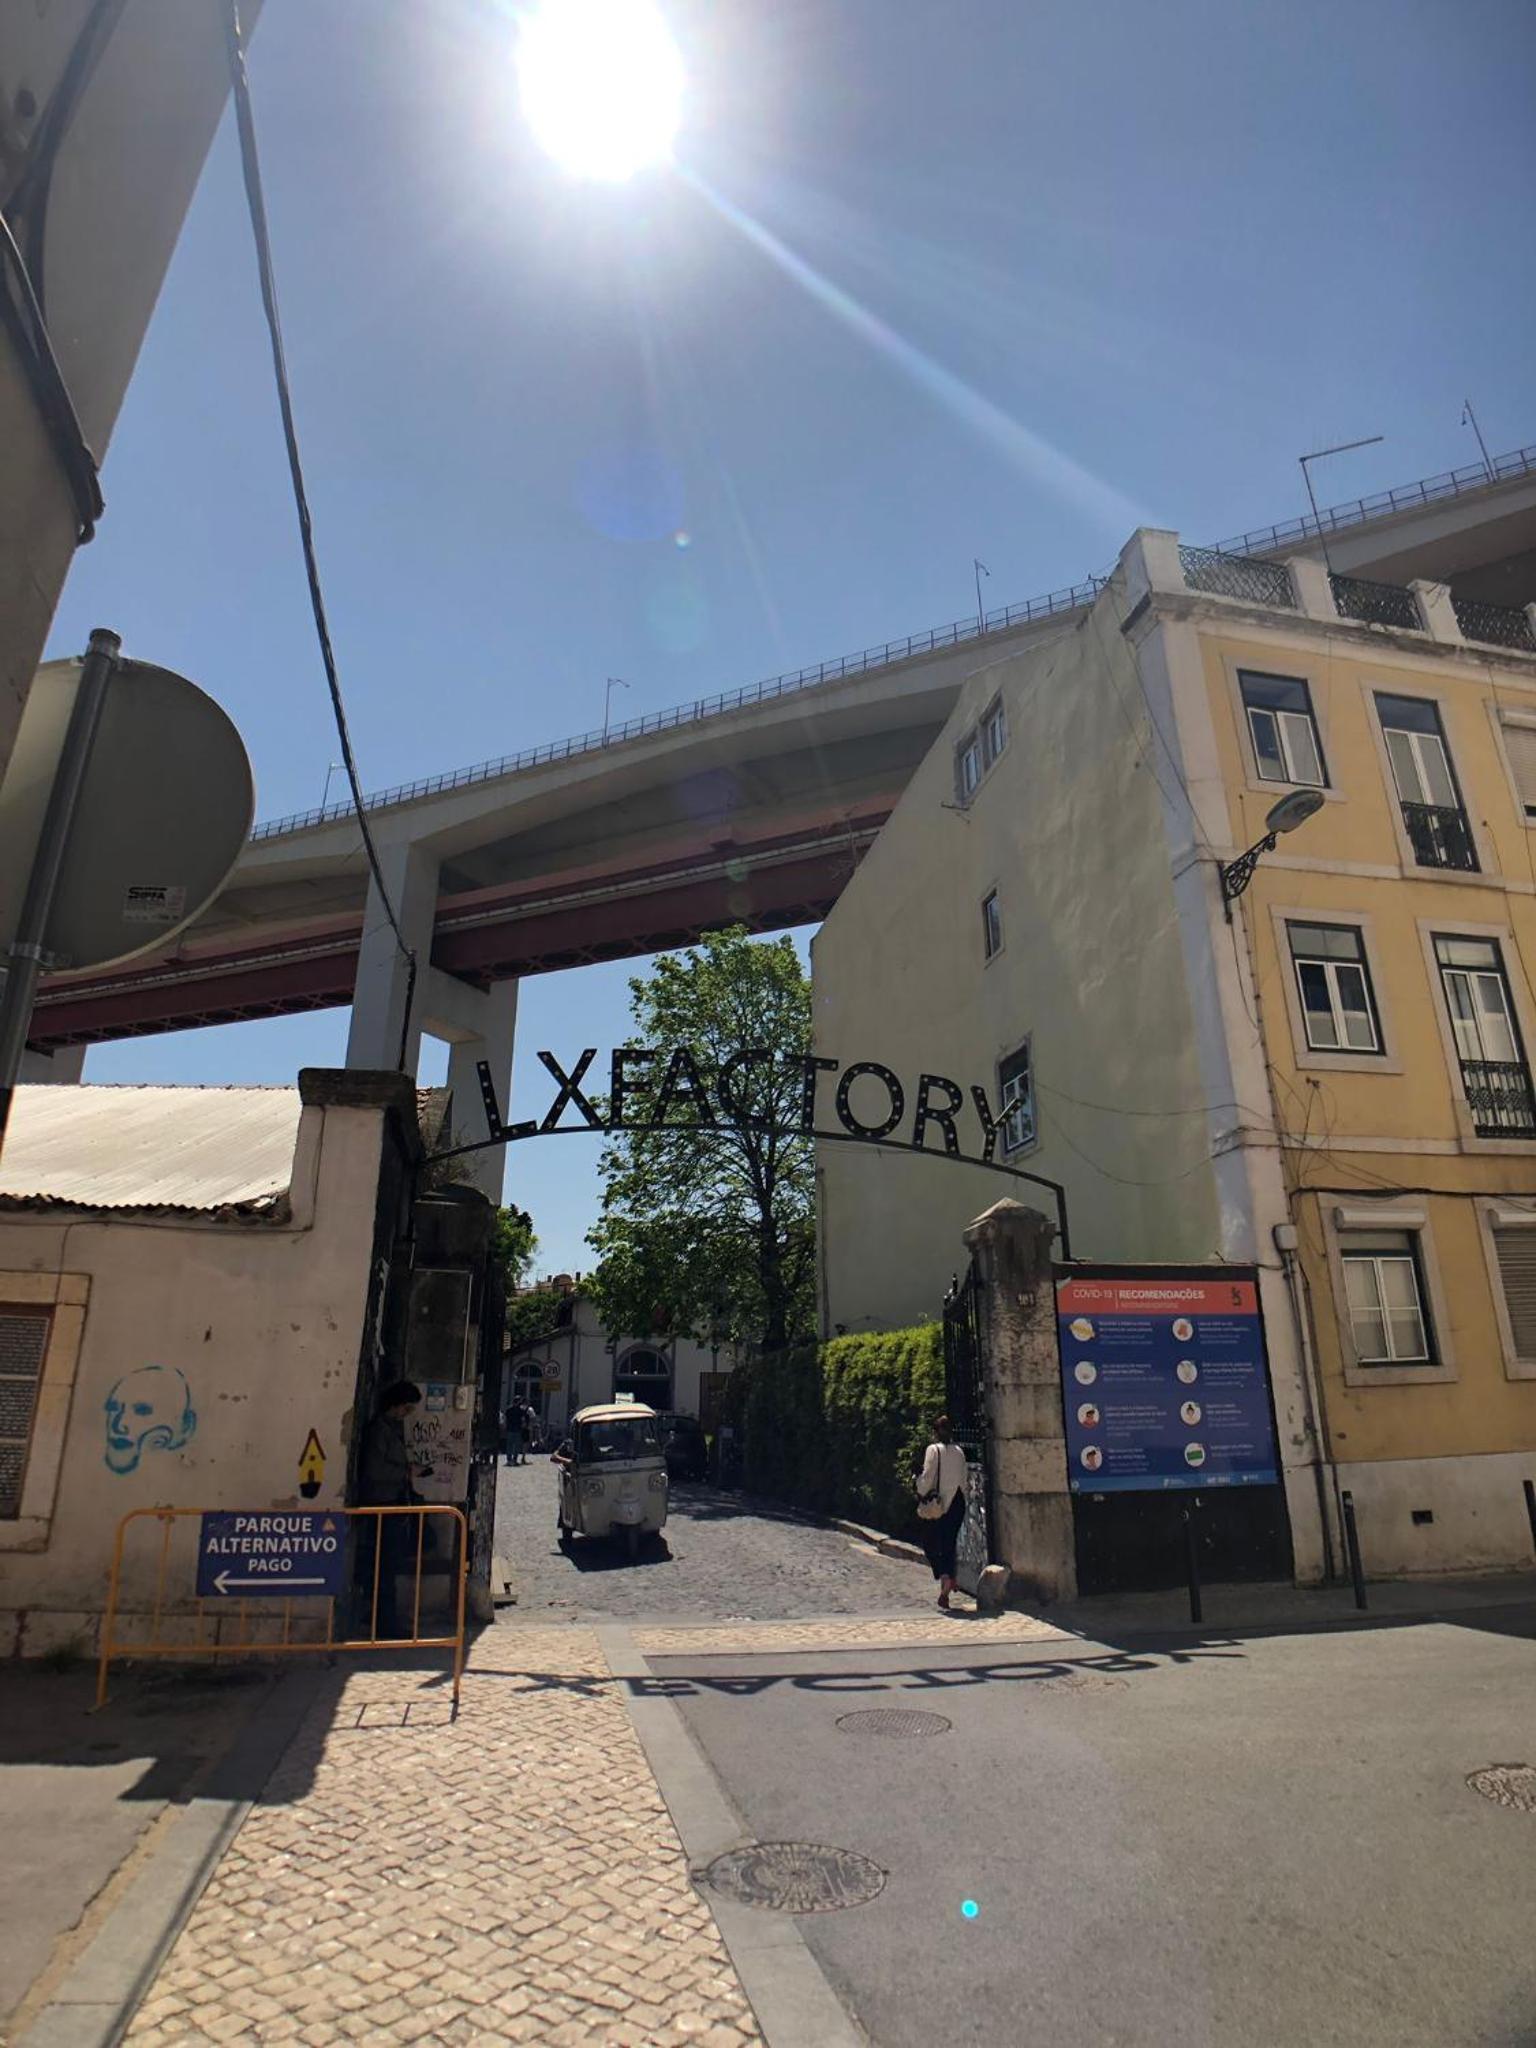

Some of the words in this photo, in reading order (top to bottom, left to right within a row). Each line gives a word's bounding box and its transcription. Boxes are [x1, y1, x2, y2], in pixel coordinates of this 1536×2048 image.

[476, 1047, 1023, 1164] LXFACTORY
[1072, 1288, 1113, 1299] COVID-19
[1118, 1287, 1206, 1301] RECOMENDAÇÕES
[235, 1517, 313, 1534] PARQUE
[206, 1537, 337, 1553] ALTERNATIVO
[248, 1558, 293, 1572] PAGO
